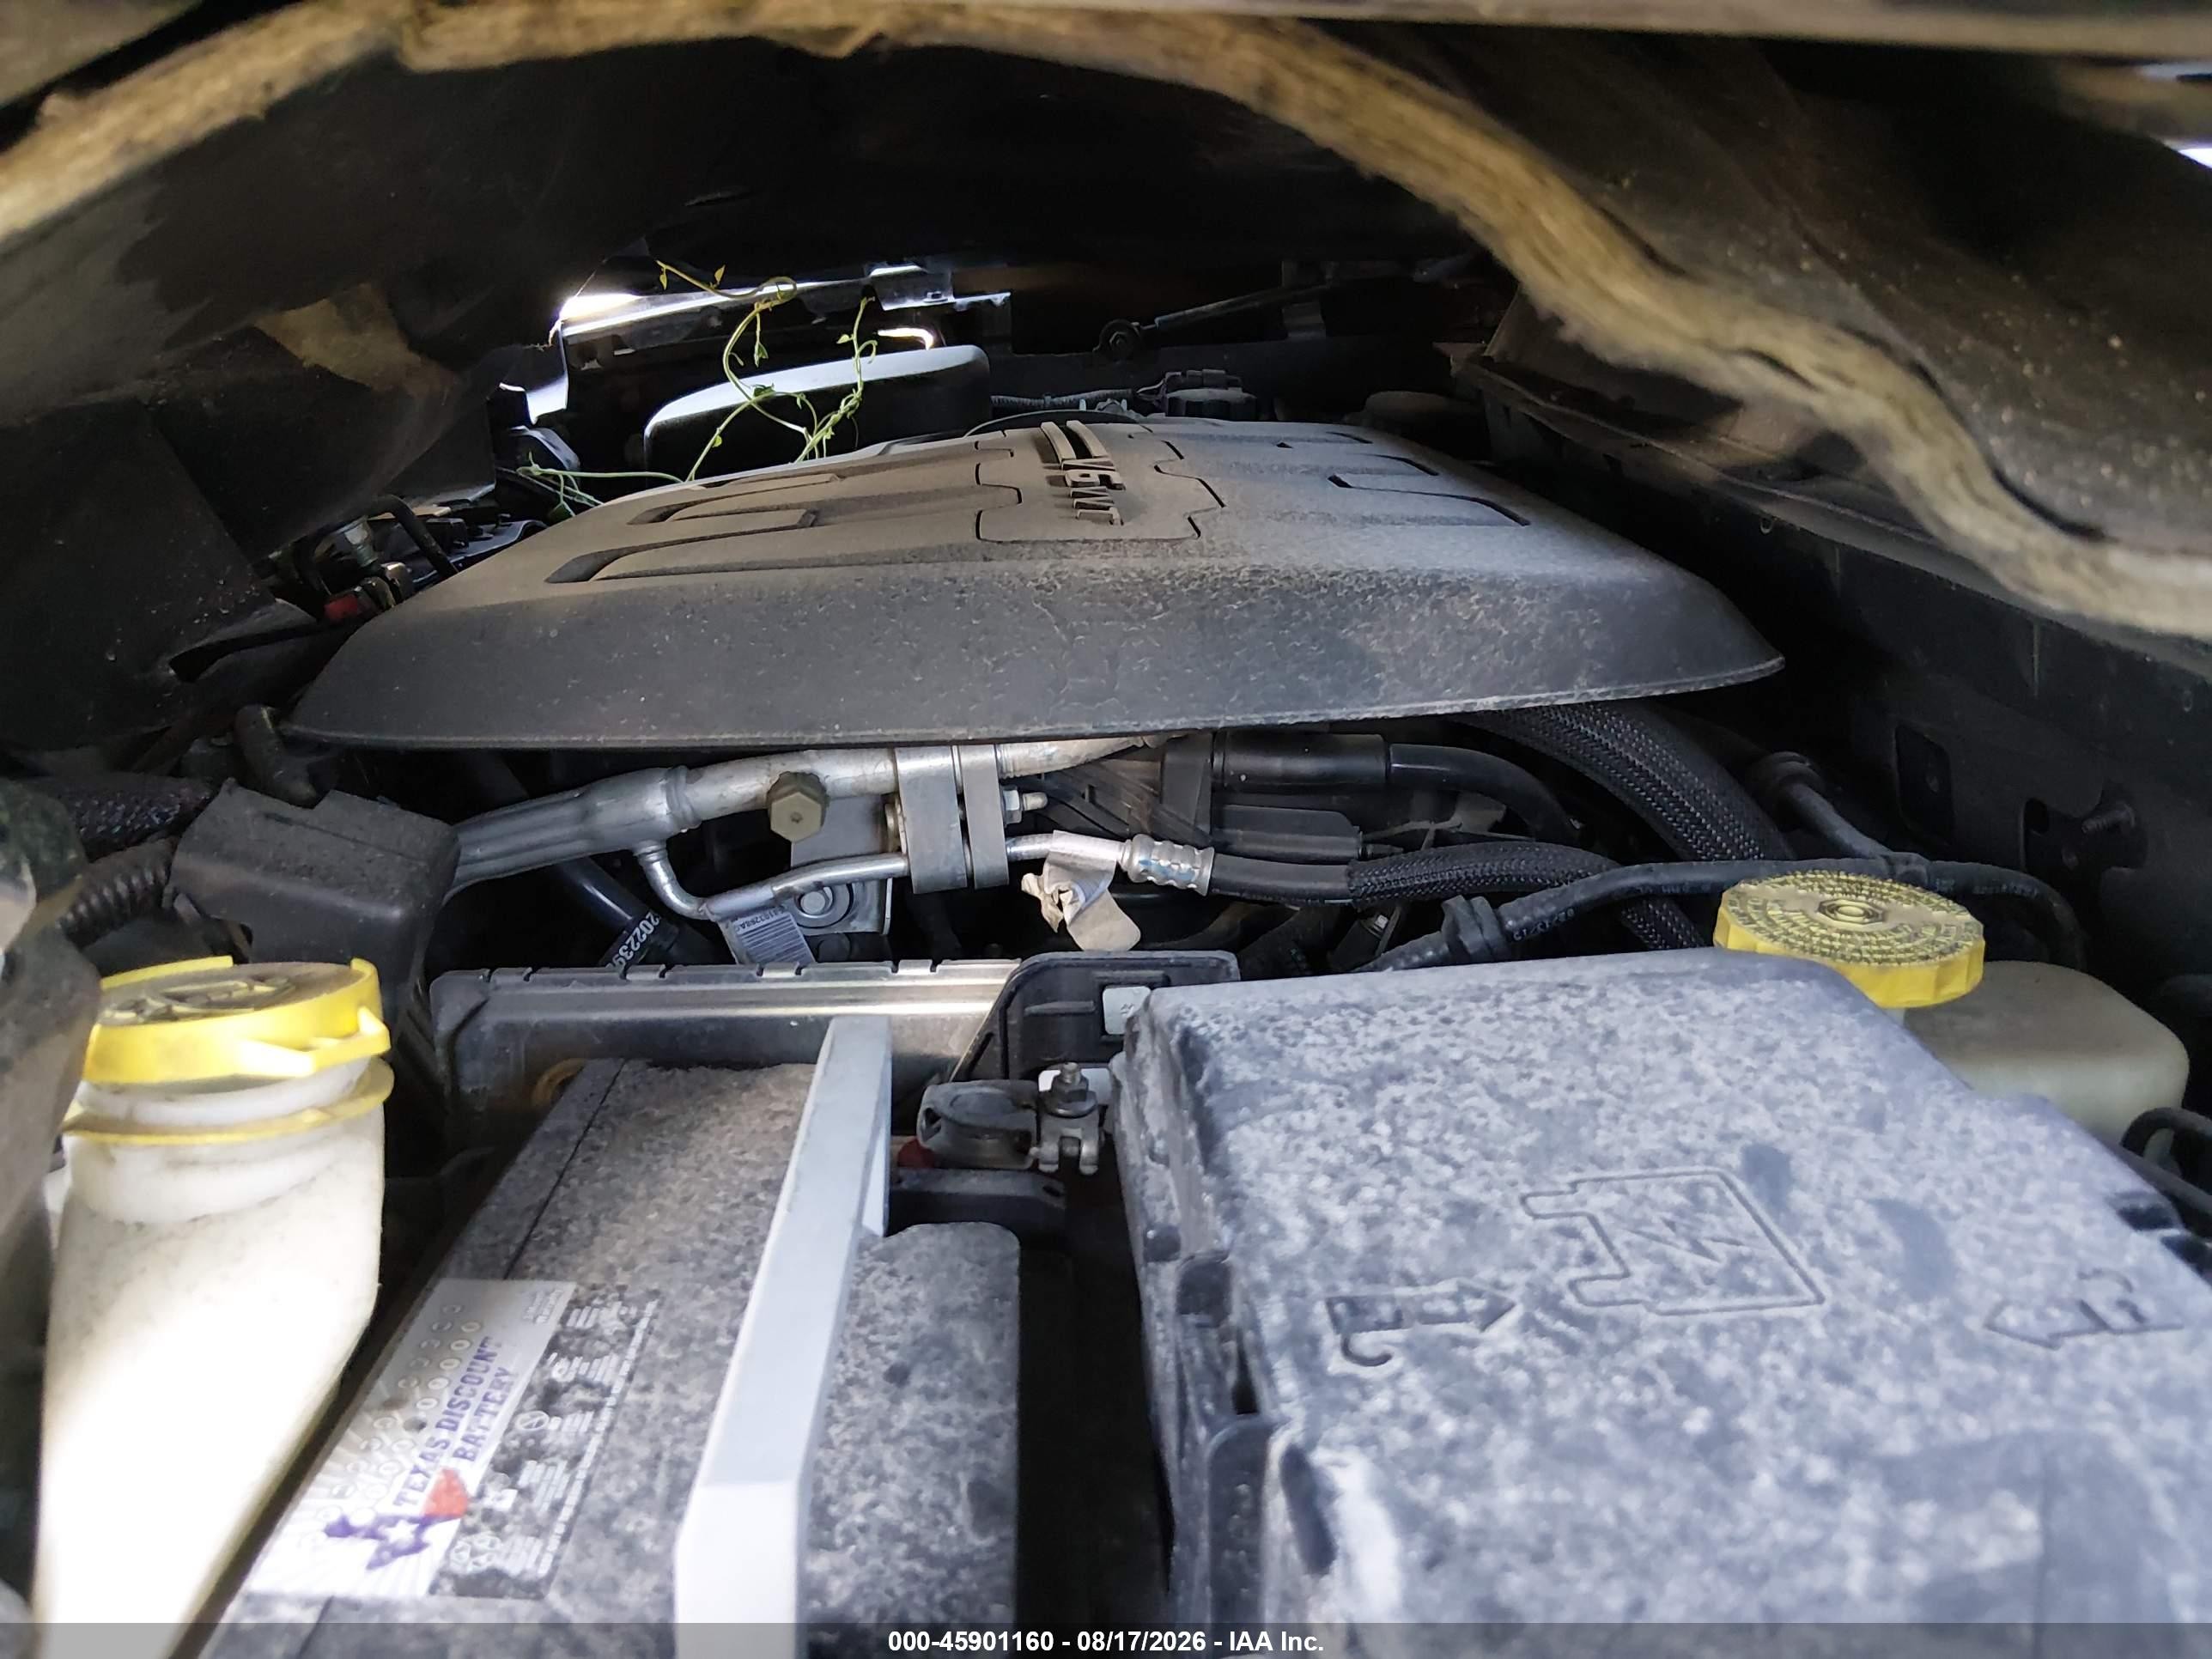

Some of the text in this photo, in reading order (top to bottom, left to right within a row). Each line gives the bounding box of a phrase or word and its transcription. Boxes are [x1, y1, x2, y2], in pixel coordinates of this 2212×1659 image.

[392, 1336, 502, 1506] TEXAS DISCOUNT
[453, 1367, 517, 1462] BATTERY
